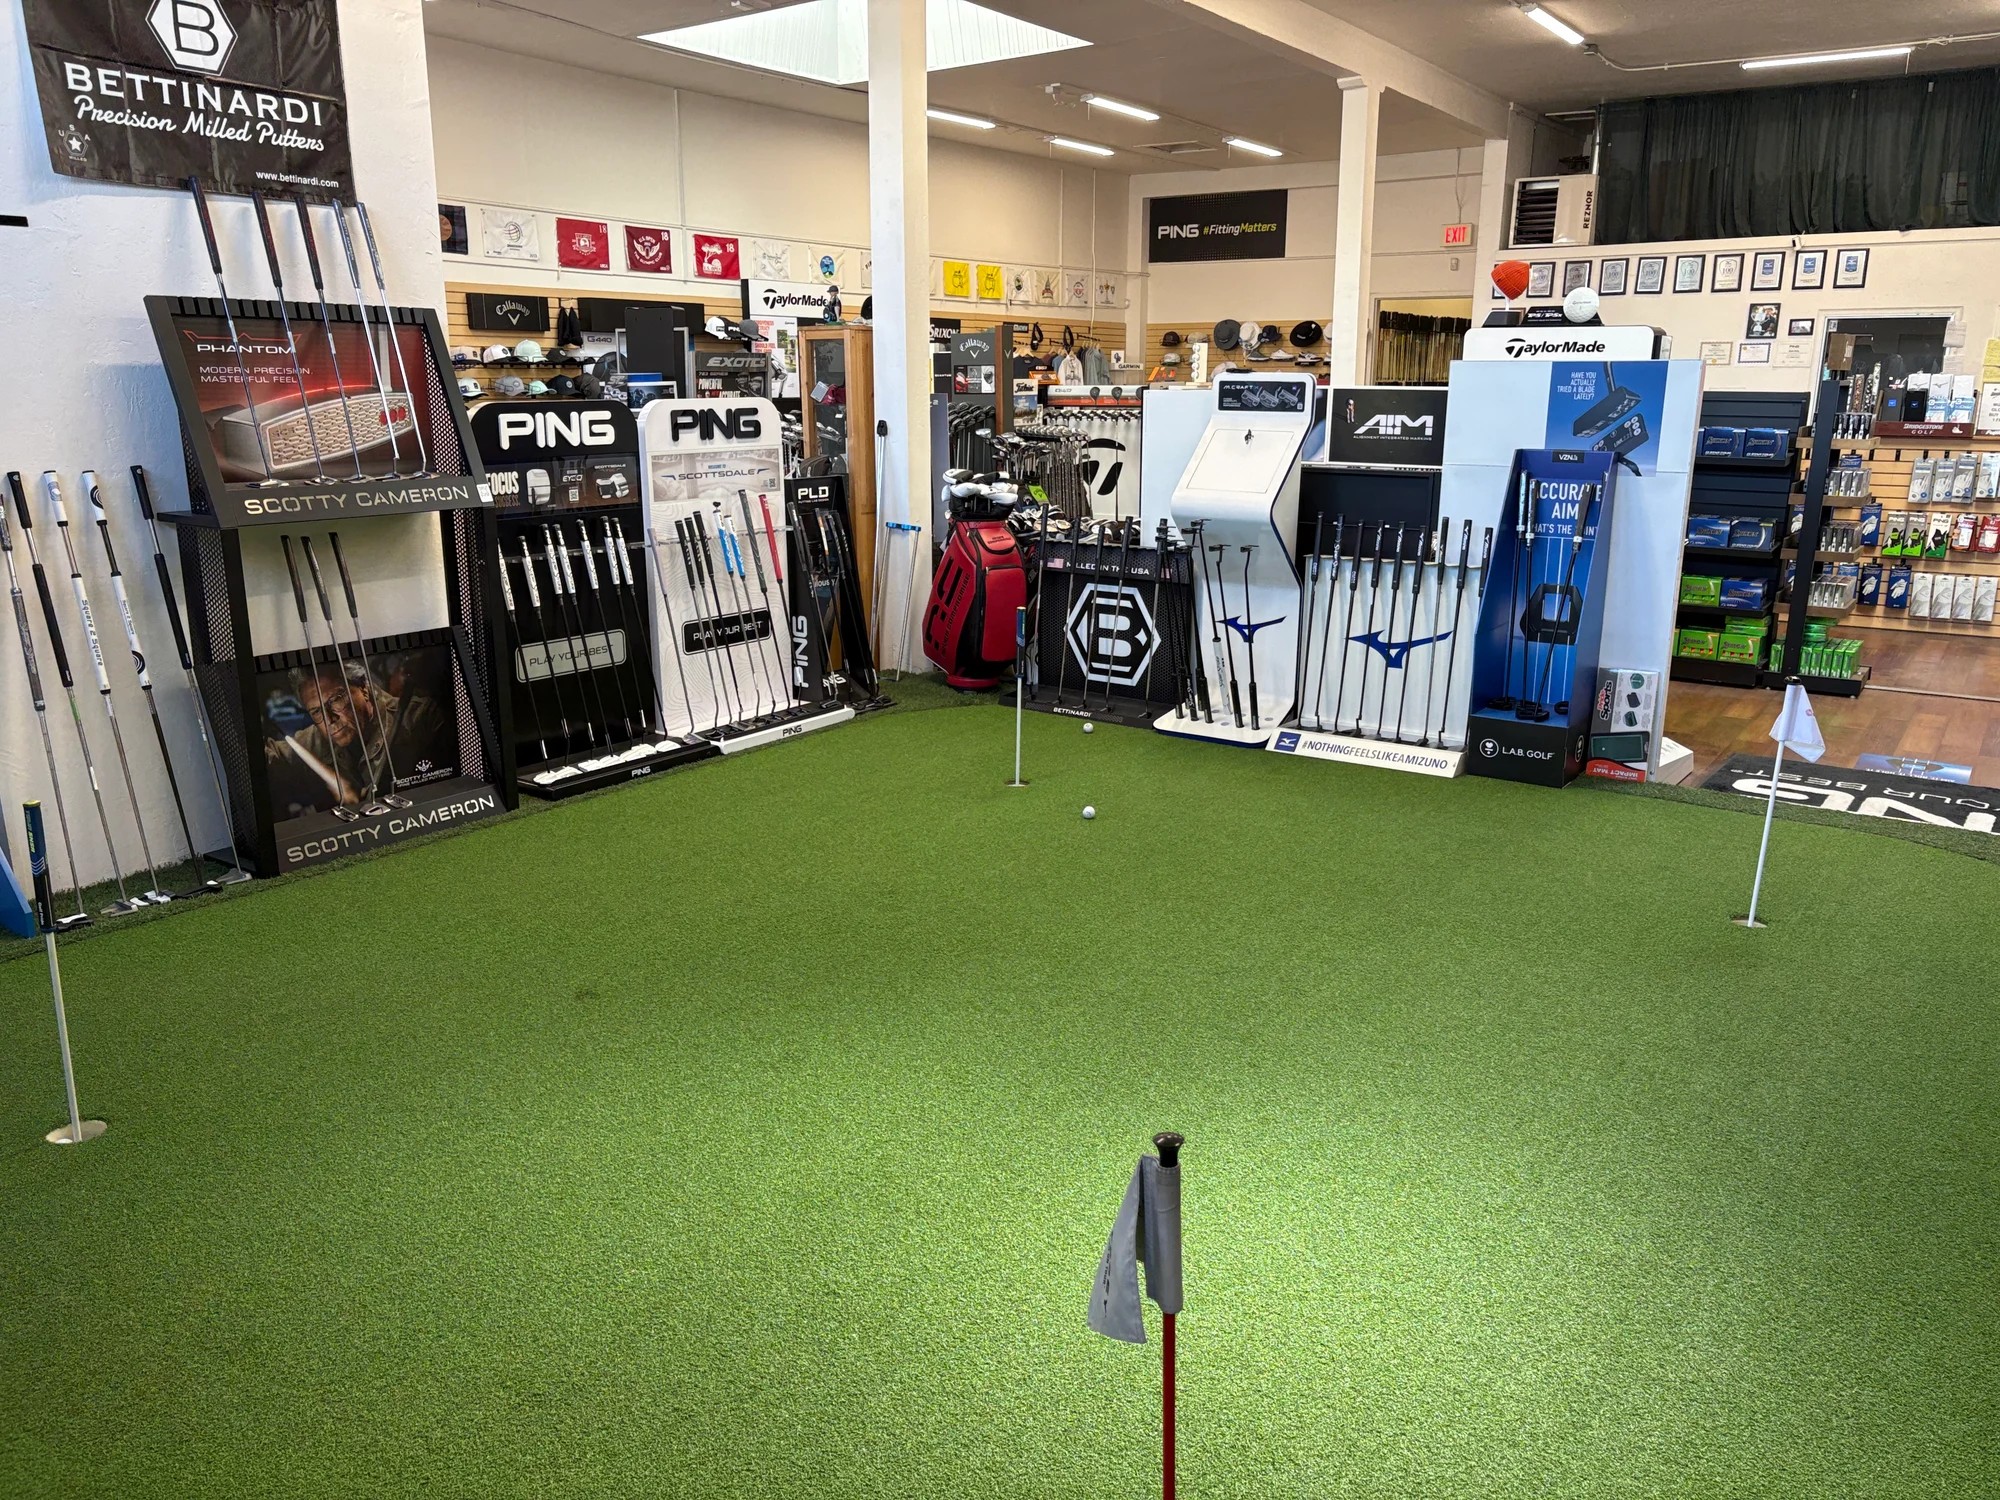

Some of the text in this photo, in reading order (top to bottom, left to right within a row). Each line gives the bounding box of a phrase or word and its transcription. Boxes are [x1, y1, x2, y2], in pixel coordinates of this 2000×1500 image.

[64, 62, 323, 126] BETTINARDI
[74, 94, 325, 152] Precision Milled Putters
[256, 170, 339, 188] www.bettinardi.com
[1582, 190, 1593, 229] REZNOR
[599, 225, 607, 234] 18
[661, 231, 669, 241] 18
[1157, 221, 1277, 240] PING #FittingMatters
[1445, 226, 1468, 244] EXIT
[725, 243, 735, 253] 18
[763, 288, 829, 310] TaylorMade
[496, 300, 530, 317] Callaway
[587, 335, 613, 343] G440
[959, 338, 990, 353] Callaway
[197, 344, 296, 355] PHANTOM
[1505, 338, 1605, 359] TaylorMade
[706, 356, 766, 368] EXOTICS
[1570, 378, 1596, 386] ACTUALLY
[1571, 371, 1585, 379] HAVE
[1557, 385, 1572, 393] TRIED
[498, 410, 616, 451] PING
[670, 407, 762, 442] PING
[1353, 414, 1434, 436] AIM
[678, 468, 757, 481] SCOTTSDALE
[484, 471, 520, 496] FOCUS
[244, 485, 469, 515] SCOTTY CAMERON
[797, 485, 830, 500] PLD
[1551, 502, 1580, 520] AIM
[1556, 524, 1573, 535] THE
[1130, 567, 1150, 576] USA
[82, 599, 94, 629] Square
[92, 638, 103, 667] Square
[792, 615, 809, 688] PING
[1600, 680, 1614, 721] Sports
[1053, 706, 1093, 718] BETTINARDI
[783, 725, 803, 737] PING
[1301, 740, 1448, 770] #NOTHINGFEELSLIKEAMIZUNO
[1526, 749, 1554, 761] GOLF
[421, 766, 453, 779] CAMERON
[631, 765, 651, 778] PING
[1610, 769, 1639, 778] IMPACT
[286, 795, 495, 864] SCOTTY CAMERON
